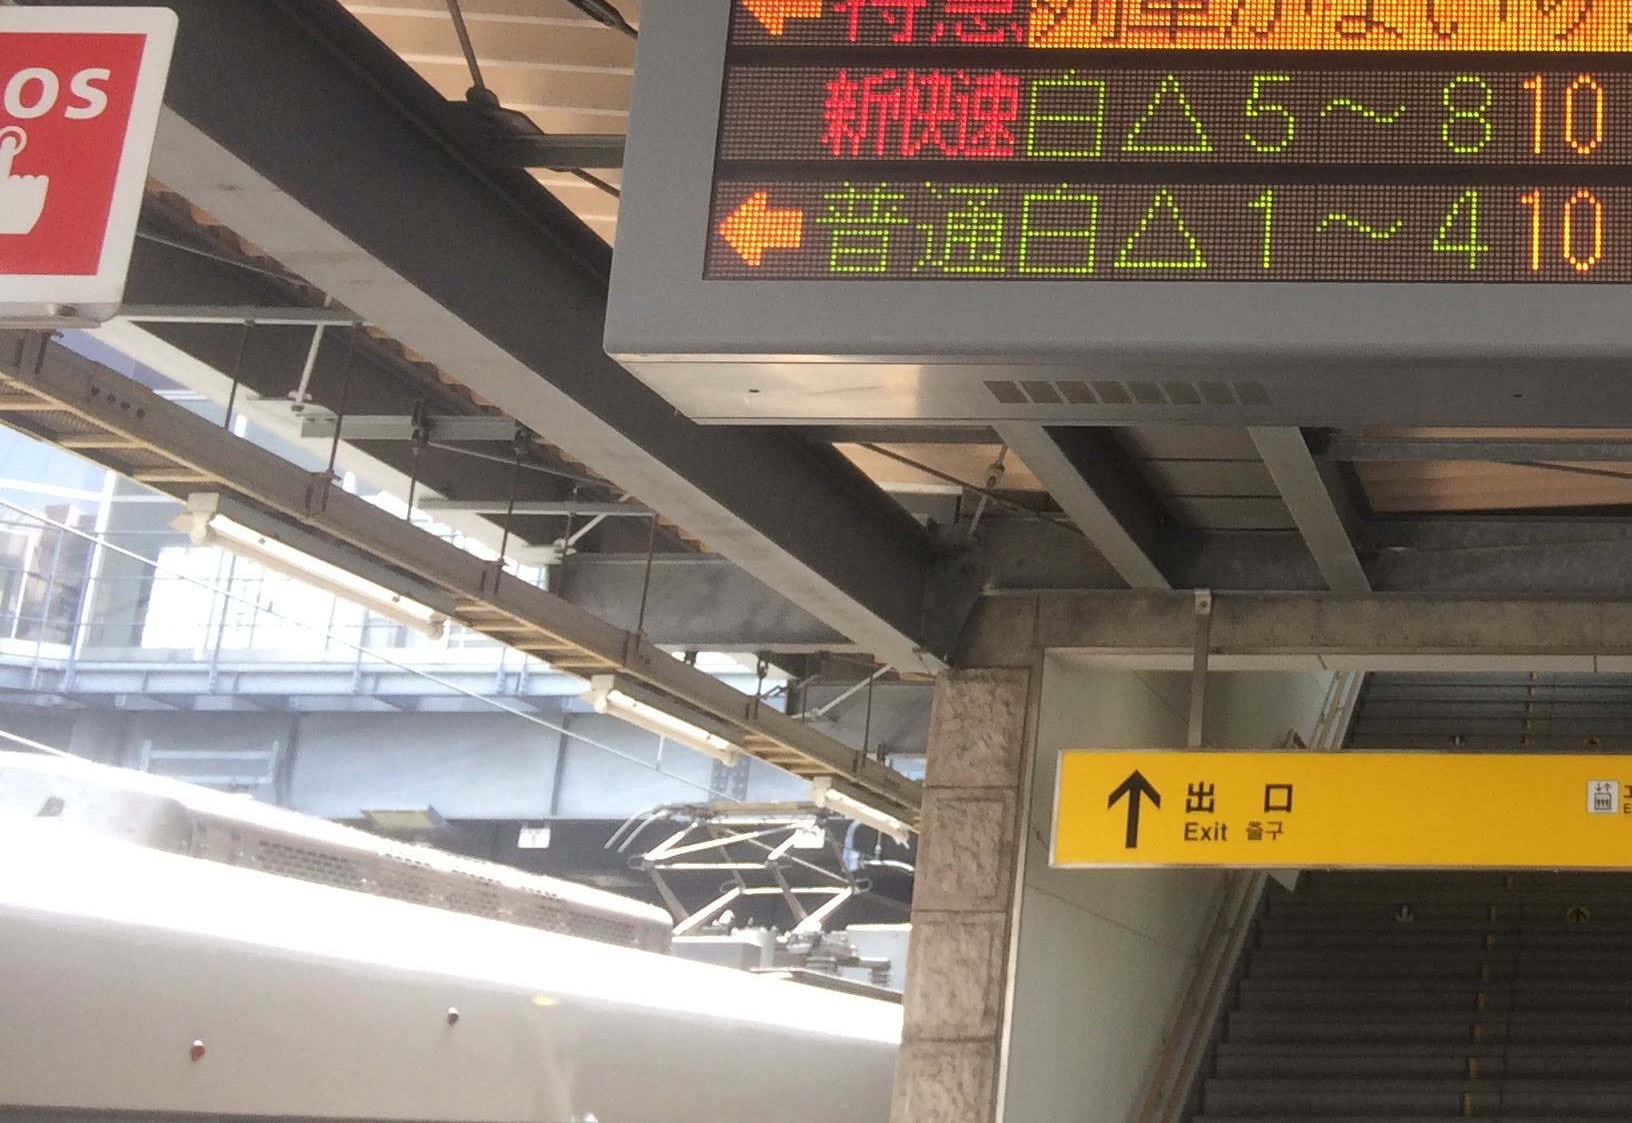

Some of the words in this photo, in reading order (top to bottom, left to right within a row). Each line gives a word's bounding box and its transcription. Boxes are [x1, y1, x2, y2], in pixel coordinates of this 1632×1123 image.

[820, 70, 1020, 158] 新快速
[1184, 821, 1228, 841] Exit
[1245, 821, 1284, 841] 출구
